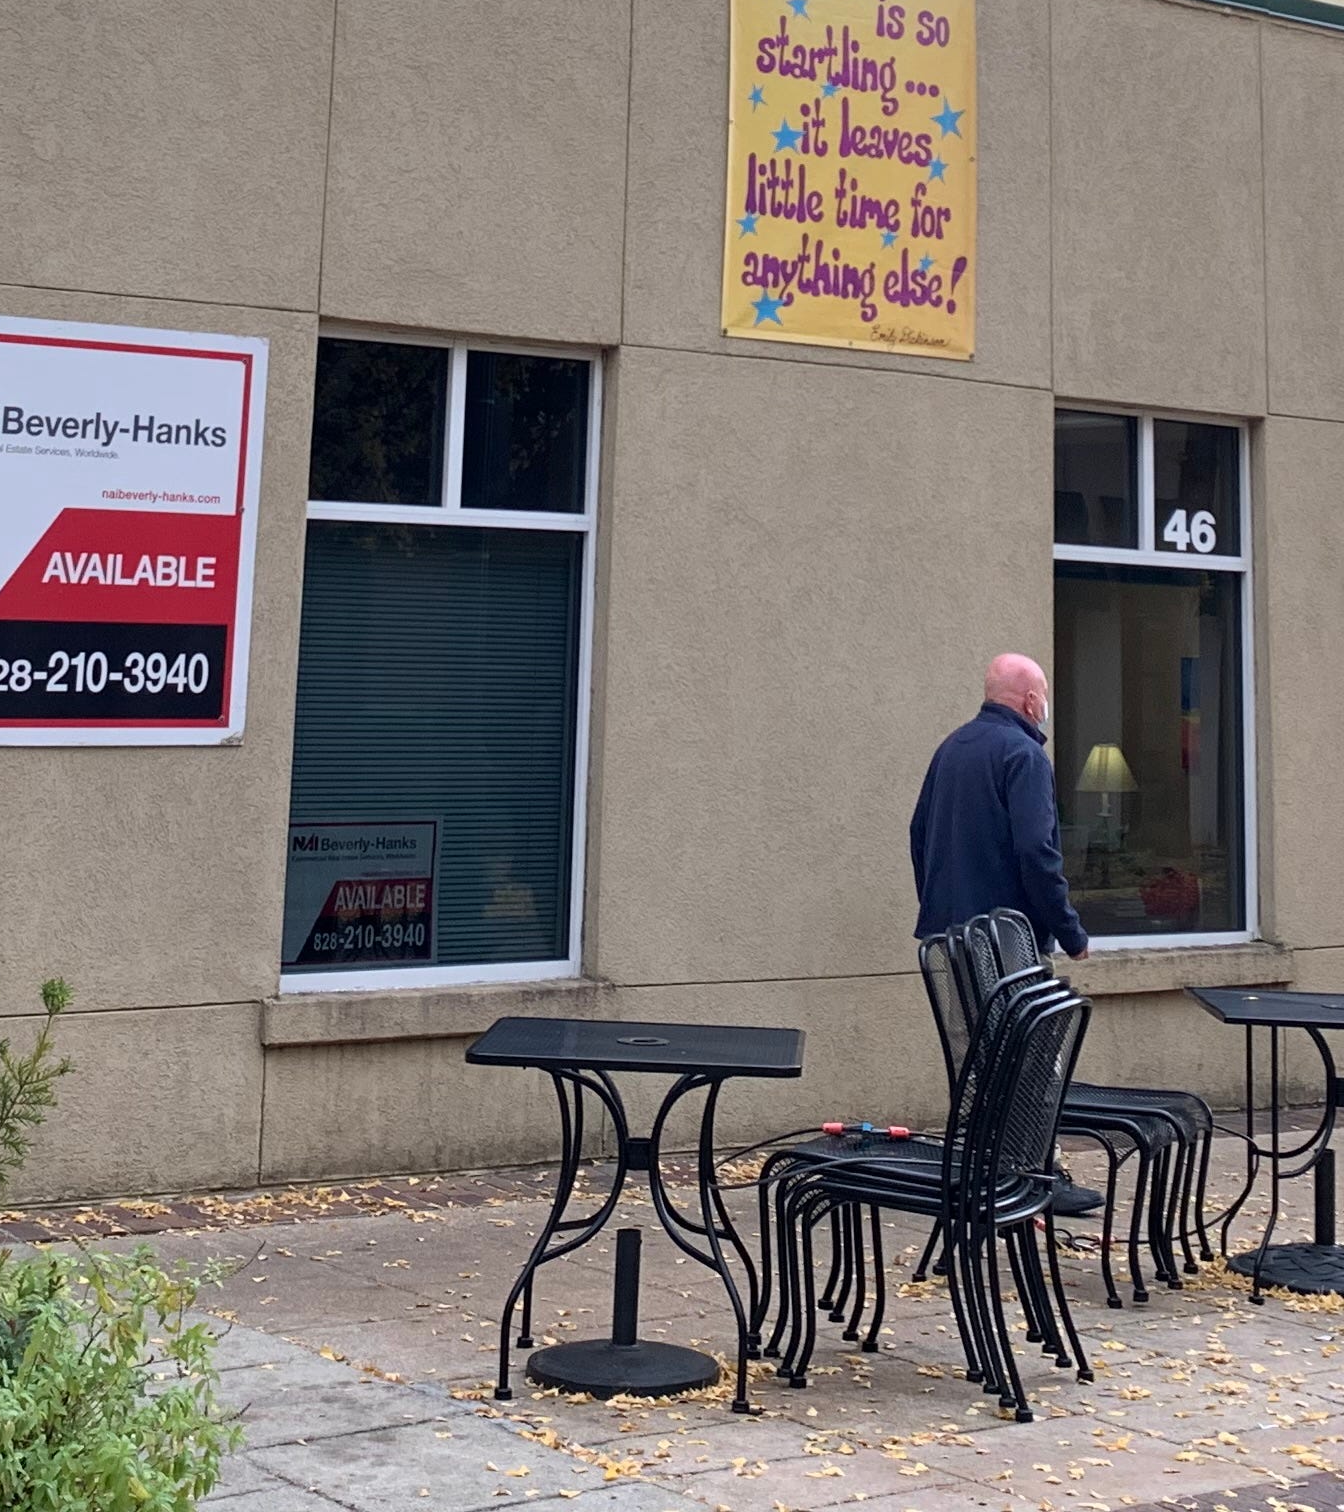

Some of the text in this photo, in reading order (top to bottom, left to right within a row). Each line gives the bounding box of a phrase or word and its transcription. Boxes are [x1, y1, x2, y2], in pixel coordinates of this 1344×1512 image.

[915, 11, 950, 48] so
[800, 96, 933, 167] it leaves
[744, 152, 951, 240] little time for
[741, 233, 968, 322] anything else!
[2, 406, 226, 447] Beverly-Hanks
[6, 444, 32, 454] Estate
[102, 489, 221, 504] naibeverly-hanks.com
[1163, 509, 1217, 553] 46
[42, 552, 217, 588] AVAILABLE
[292, 833, 416, 853] NAI Beverly-Hanks
[334, 884, 426, 911] AVAILABLE
[313, 923, 425, 951] 828-210-3940
